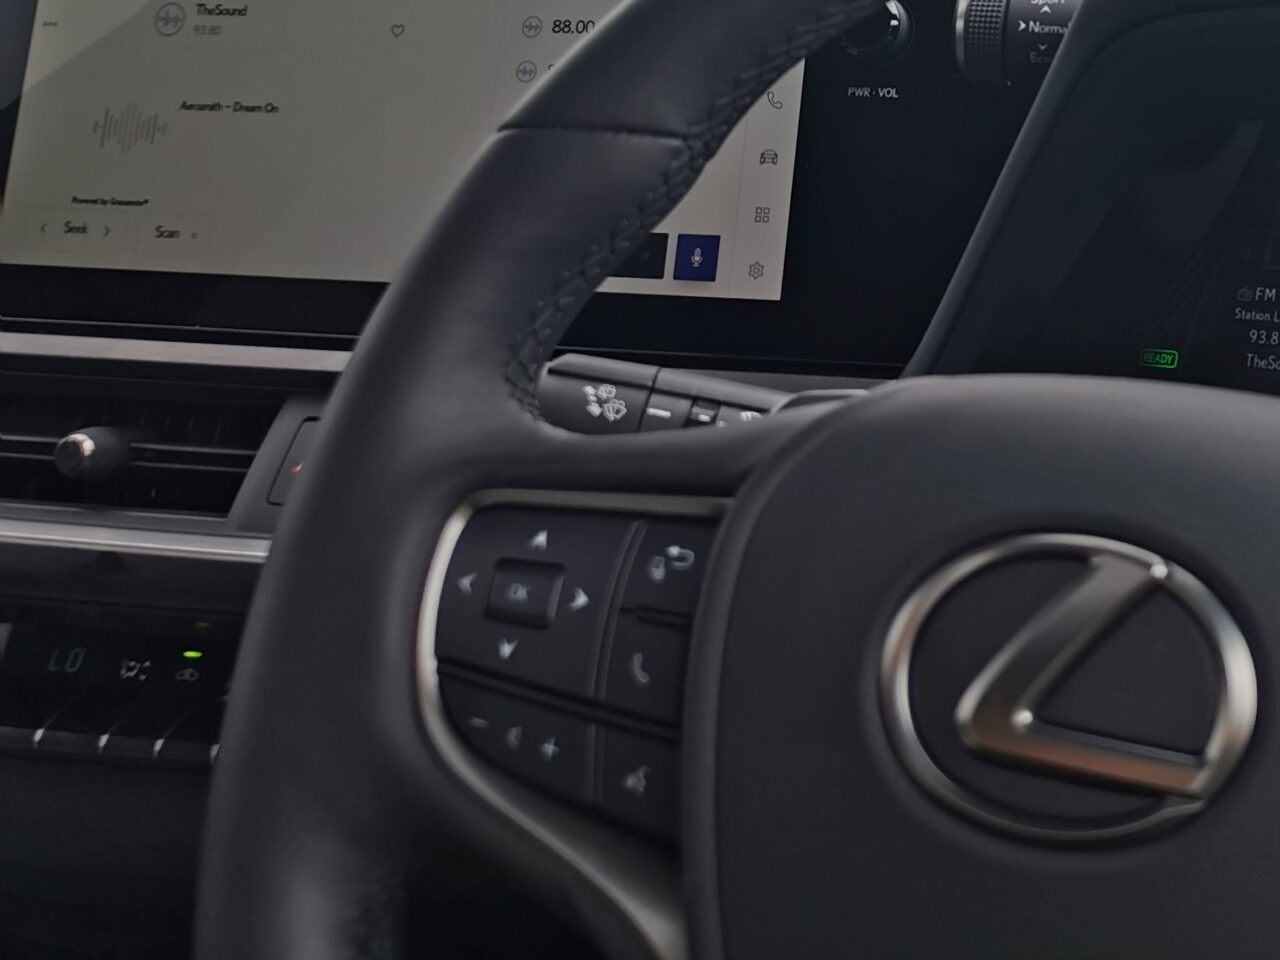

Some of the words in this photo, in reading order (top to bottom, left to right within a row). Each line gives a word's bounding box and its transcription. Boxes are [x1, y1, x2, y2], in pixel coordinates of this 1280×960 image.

[196, 3, 249, 17] TheSound
[848, 87, 871, 98] PWR
[878, 88, 899, 98] VOL
[264, 102, 280, 113] On
[64, 220, 88, 234] Seek
[155, 225, 180, 238] Scan
[1255, 287, 1277, 302] FM
[1235, 307, 1271, 321] Station
[1143, 352, 1175, 365] READY
